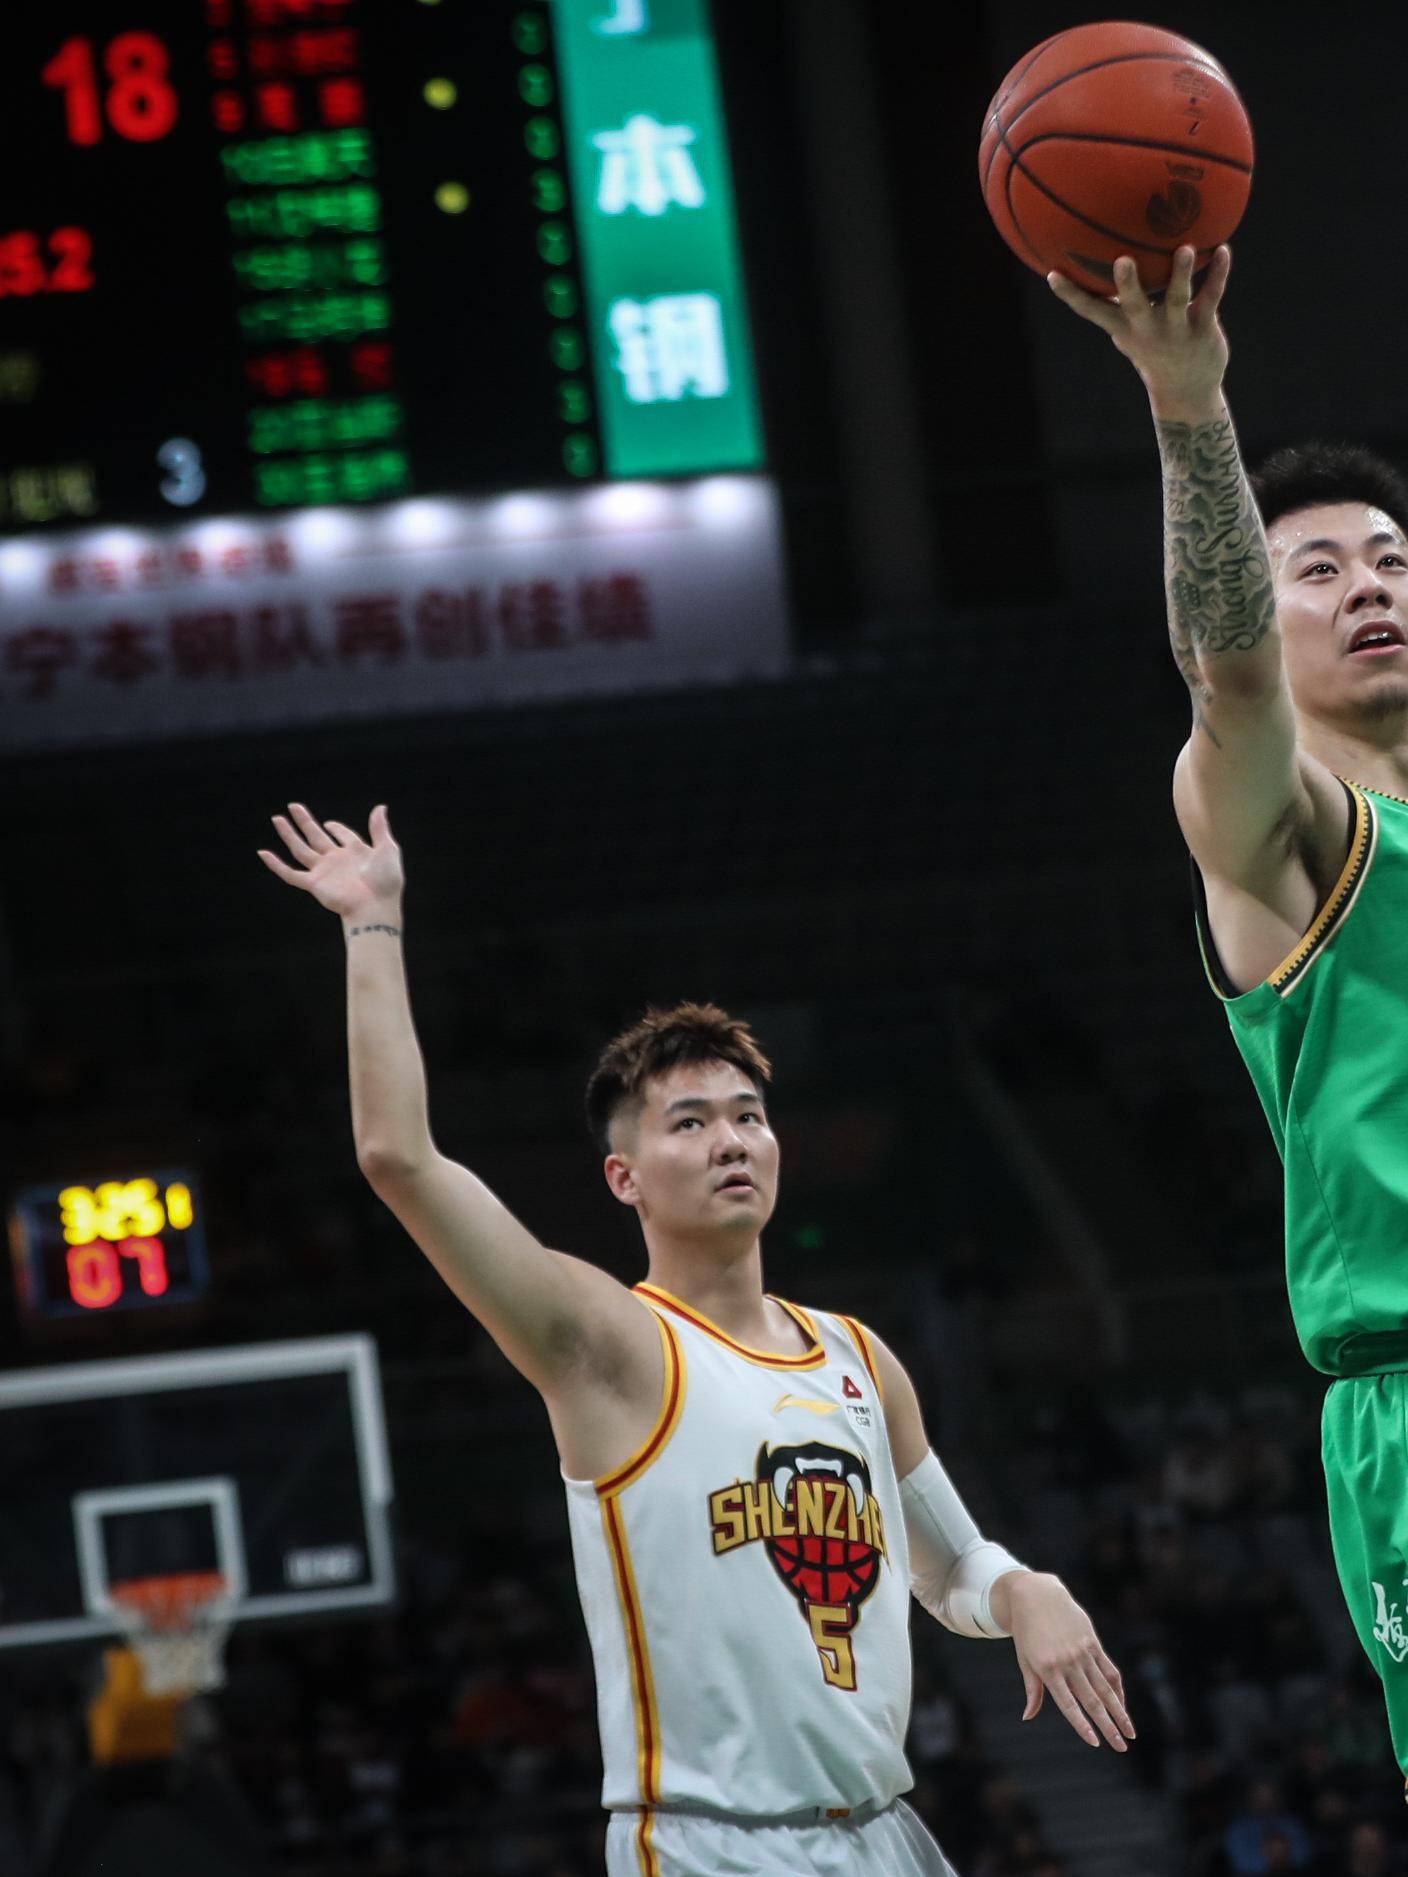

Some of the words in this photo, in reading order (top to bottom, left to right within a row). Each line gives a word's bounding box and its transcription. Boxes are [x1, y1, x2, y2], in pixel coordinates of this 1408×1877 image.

[44, 32, 178, 146] 18
[157, 437, 206, 506] 3
[65, 1235, 169, 1309] 07
[708, 1478, 889, 1556] SHENZHE
[805, 1600, 857, 1692] 5
